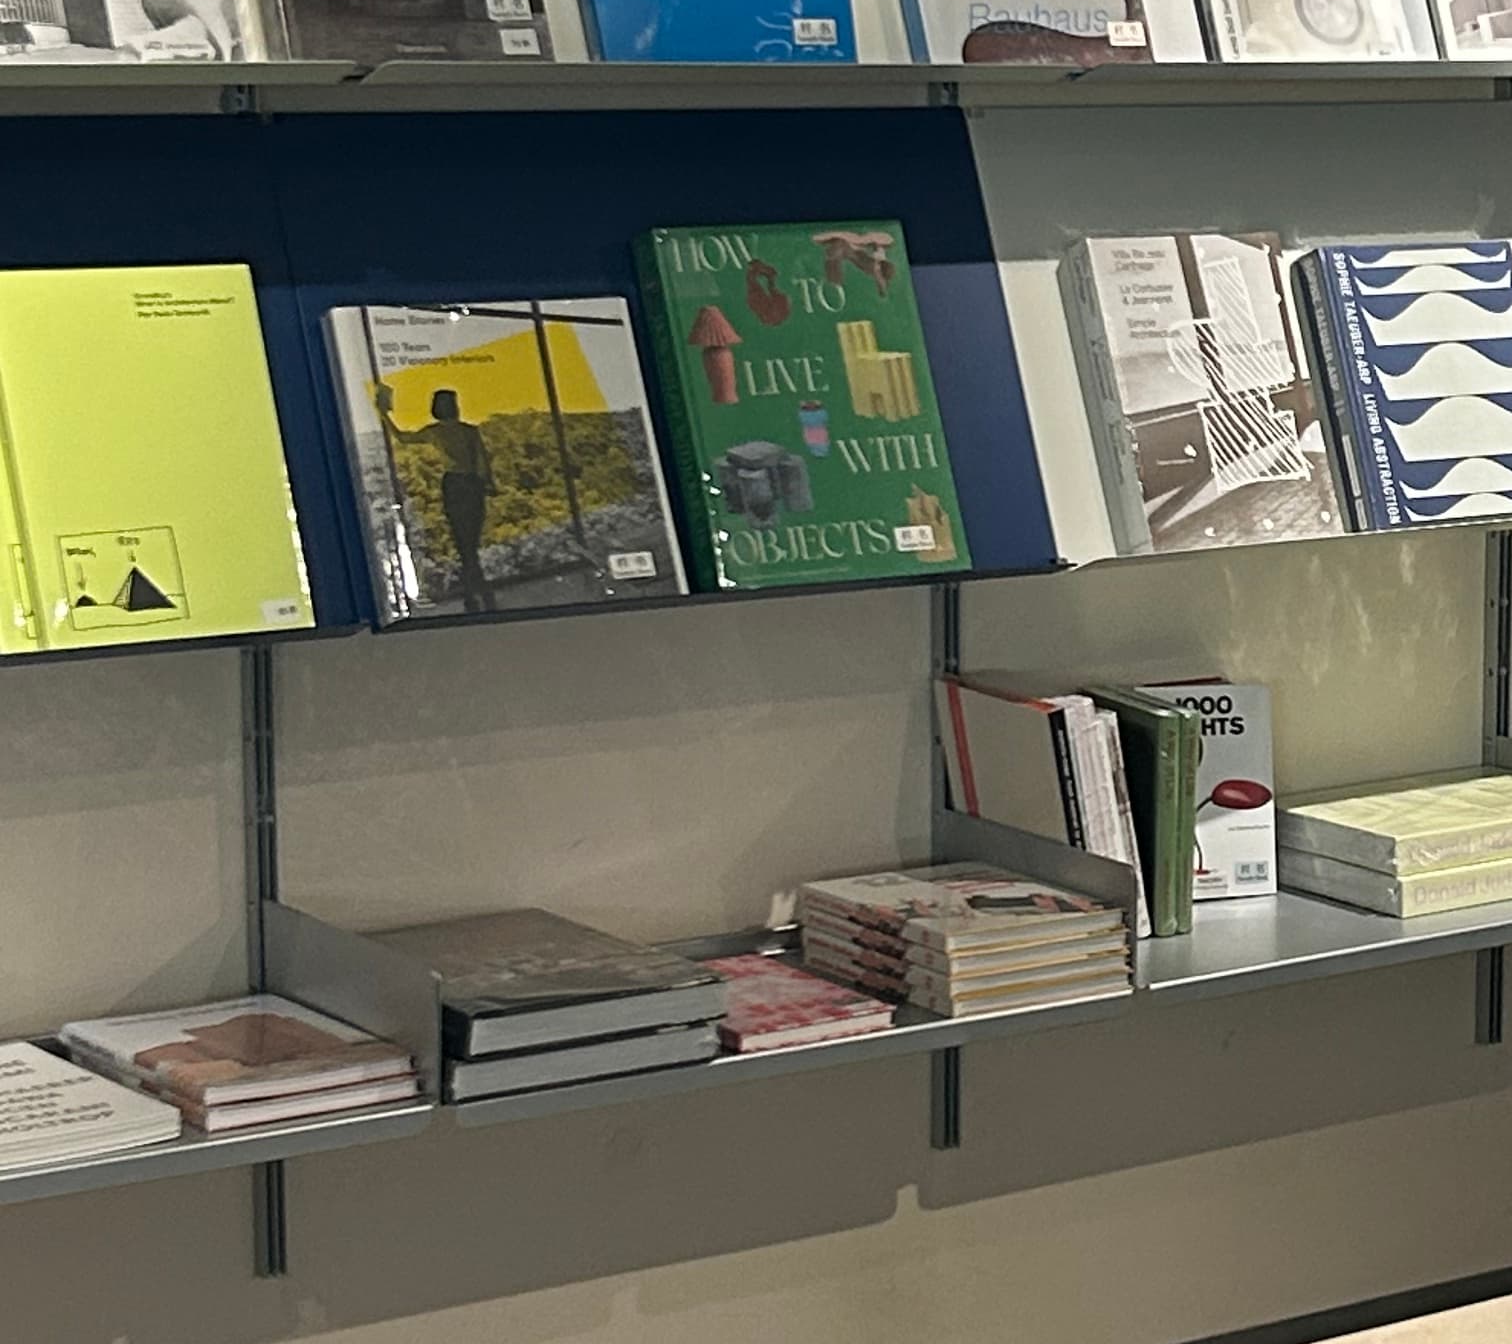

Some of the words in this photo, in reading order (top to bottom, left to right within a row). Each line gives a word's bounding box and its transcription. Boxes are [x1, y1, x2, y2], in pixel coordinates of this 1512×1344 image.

[667, 233, 760, 273] HOW
[793, 276, 847, 315] TO
[1332, 251, 1354, 298] SOPHIE
[742, 355, 831, 397] LIVE
[1363, 392, 1383, 435] LIVING
[836, 433, 940, 475] WITH
[1371, 435, 1402, 525] ABSTRACTION
[727, 519, 893, 568] OBJECTS
[1200, 716, 1245, 737] HTS
